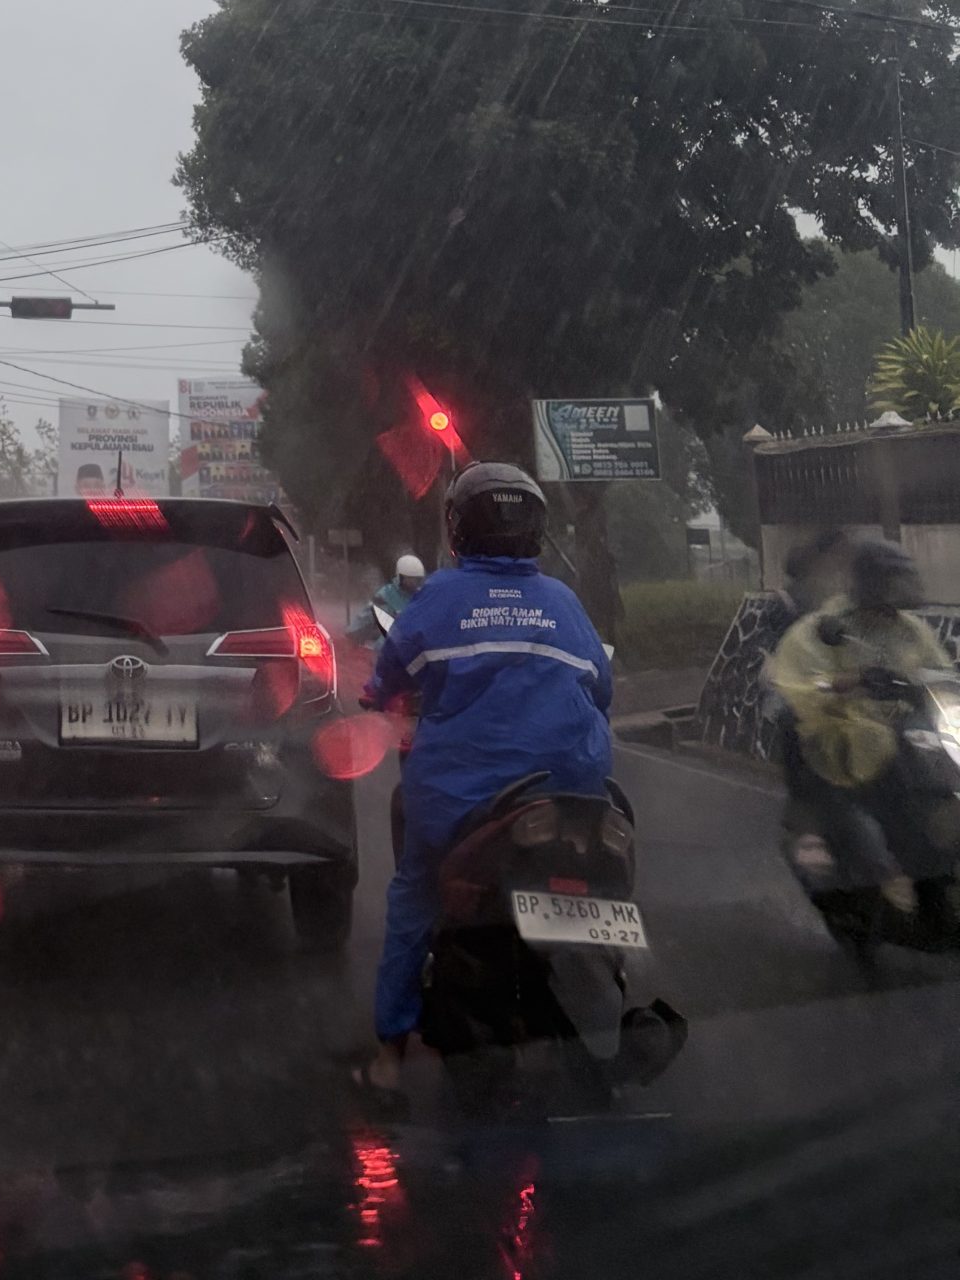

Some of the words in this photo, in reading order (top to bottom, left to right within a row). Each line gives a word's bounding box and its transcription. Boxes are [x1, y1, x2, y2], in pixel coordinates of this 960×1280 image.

[190, 400, 242, 409] REPUBLIK
[88, 434, 137, 443] PROVINSI
[71, 442, 130, 451] KEPULAUAN
[132, 443, 154, 452] RIAU
[492, 493, 523, 503] YAMAHA
[472, 607, 509, 618] RIDING
[511, 607, 543, 617] AMAN
[460, 618, 488, 630] BIKIN
[490, 616, 514, 626] HATI
[516, 617, 556, 629] TENANG
[68, 703, 93, 723] BP
[516, 894, 539, 914] BP
[551, 897, 600, 919] 5260
[611, 903, 638, 924] MK
